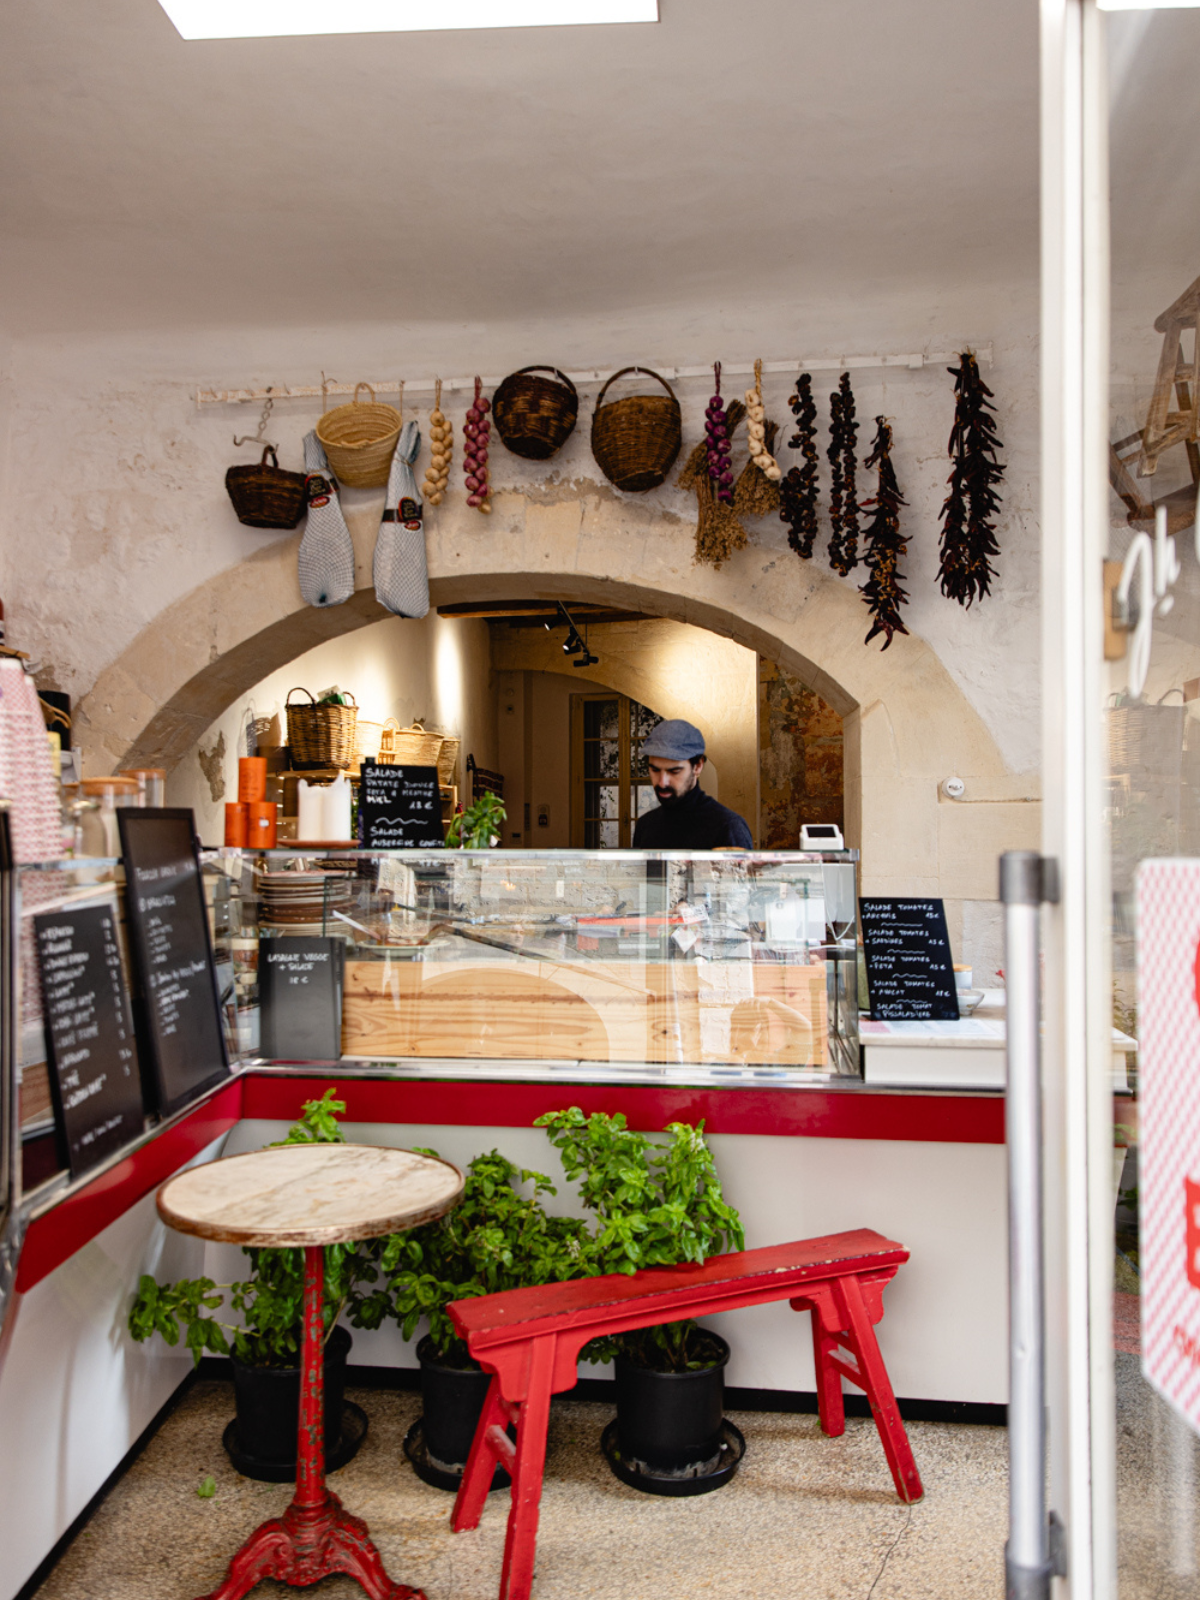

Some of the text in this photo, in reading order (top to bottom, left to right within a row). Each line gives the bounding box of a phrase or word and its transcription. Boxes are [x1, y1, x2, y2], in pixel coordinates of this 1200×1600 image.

[365, 768, 403, 778] SALADE
[366, 778, 399, 788] PATATE
[366, 795, 392, 804] MIEL
[370, 826, 403, 837] SALADE
[371, 838, 414, 847] AUBERGINE
[864, 902, 934, 912] SALADE TOMATES
[868, 928, 930, 937] SALADE TOMATES
[872, 937, 903, 945] SARDINES
[288, 963, 314, 971] SALADE
[873, 979, 936, 988] SALADE TOMATES
